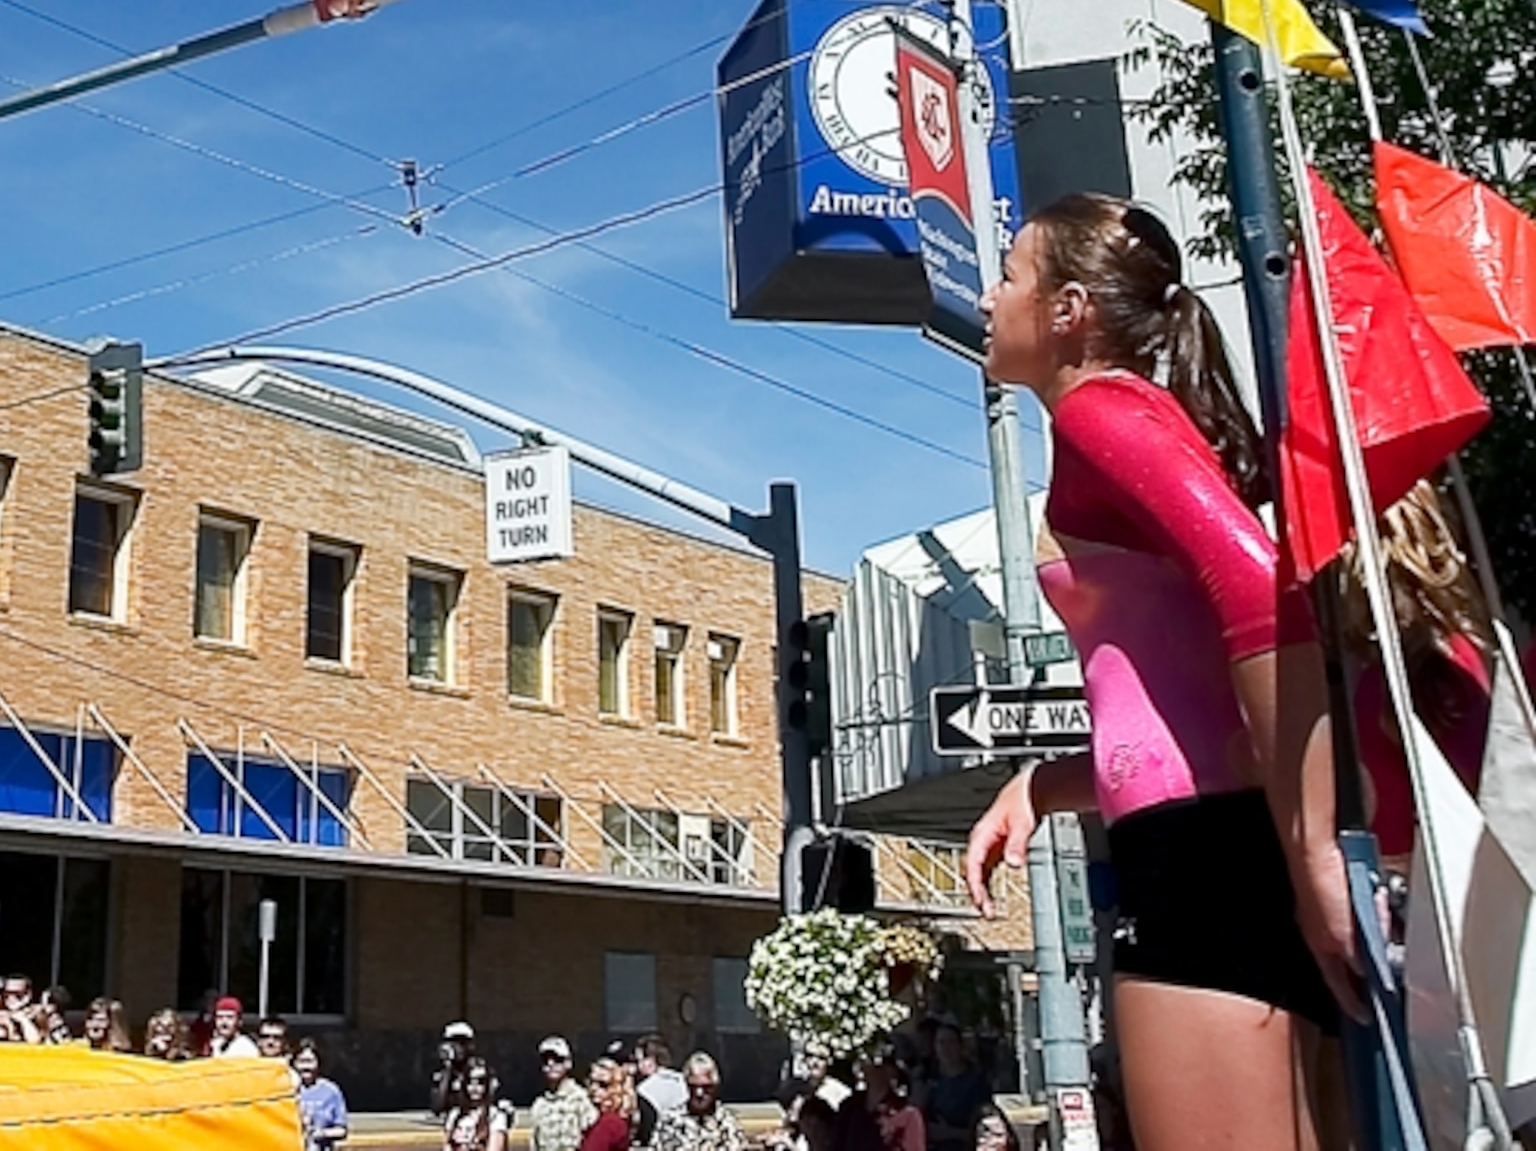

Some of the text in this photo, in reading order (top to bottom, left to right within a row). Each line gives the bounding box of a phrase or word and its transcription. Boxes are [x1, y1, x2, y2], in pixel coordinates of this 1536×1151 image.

[505, 466, 536, 491] NO
[495, 494, 549, 521] RIGHT
[498, 524, 548, 548] TURN
[989, 706, 1038, 731] ONE
